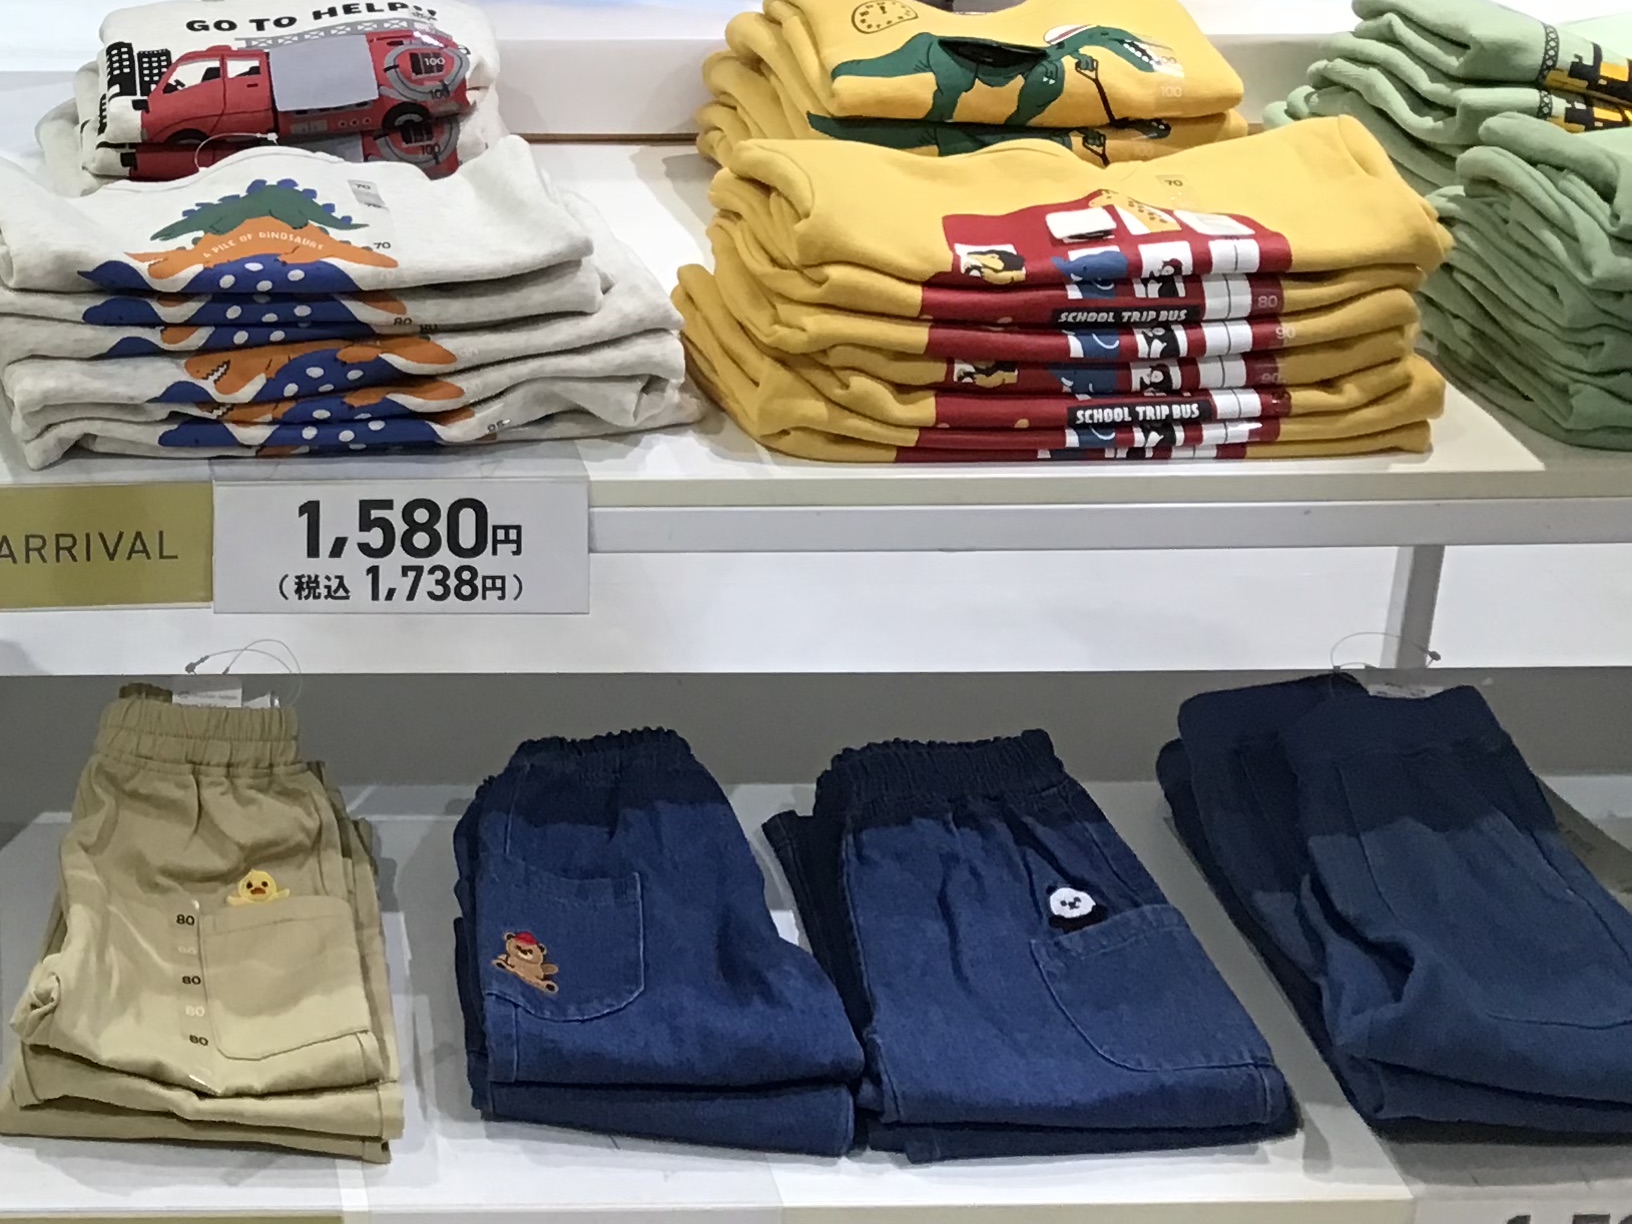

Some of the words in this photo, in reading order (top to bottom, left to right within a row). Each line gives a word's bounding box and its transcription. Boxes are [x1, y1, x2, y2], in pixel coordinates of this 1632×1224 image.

[185, 19, 238, 32] GO
[249, 16, 297, 31] TO
[424, 57, 445, 66] 100
[1160, 86, 1183, 97] 100
[374, 240, 391, 250] 70
[1257, 295, 1278, 308] 80
[1058, 311, 1116, 323] SCHOOL
[1121, 309, 1158, 323] TRIP
[1158, 308, 1189, 322] BUS
[1275, 327, 1296, 340] 90
[1076, 408, 1132, 424] SCHOOL
[1135, 405, 1171, 420] TRIP
[1171, 402, 1200, 419] BUS
[298, 498, 522, 559] 1,580円
[176, 914, 195, 926] 80
[182, 975, 202, 985] 80
